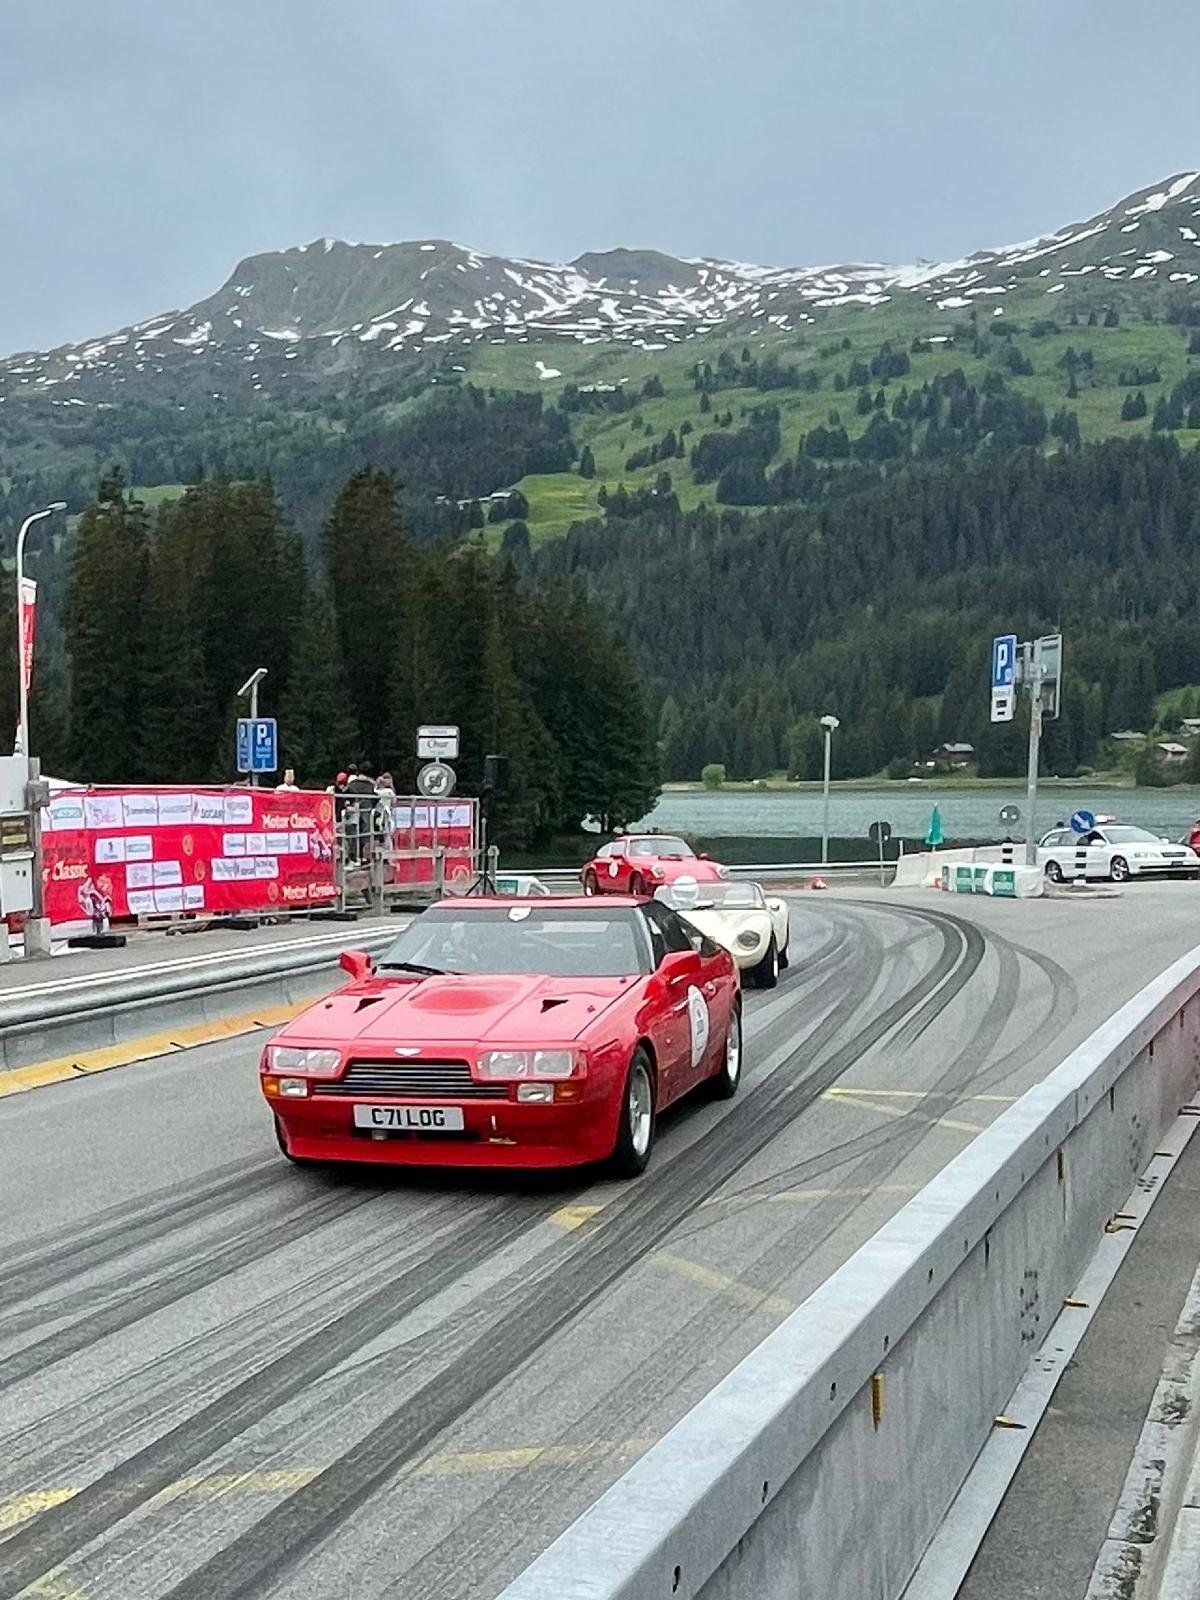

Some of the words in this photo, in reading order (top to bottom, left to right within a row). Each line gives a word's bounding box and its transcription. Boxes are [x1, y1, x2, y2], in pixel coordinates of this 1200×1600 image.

[996, 643, 1008, 680] P
[257, 724, 267, 745] P
[52, 860, 88, 881] Classic
[371, 1108, 402, 1125] C71
[406, 1109, 446, 1127] LOG
